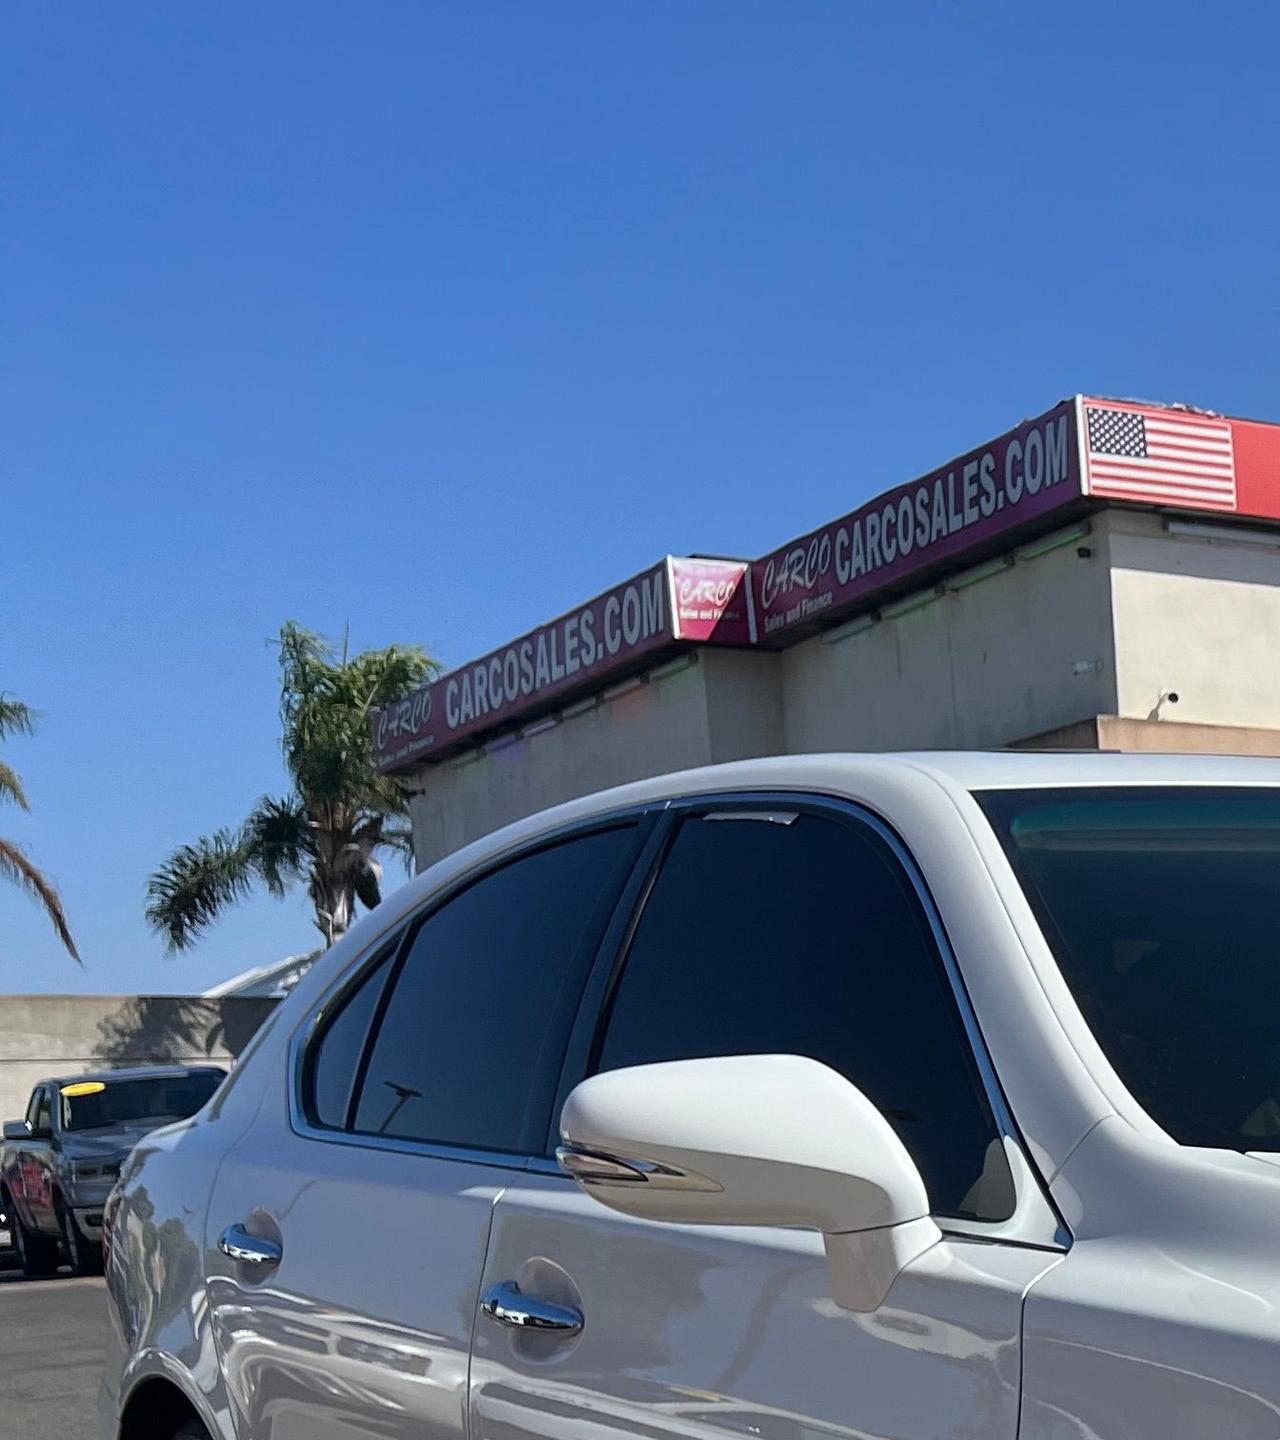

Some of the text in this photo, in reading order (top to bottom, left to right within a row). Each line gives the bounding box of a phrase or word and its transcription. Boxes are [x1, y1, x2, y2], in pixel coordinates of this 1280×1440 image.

[761, 533, 832, 609] CARCO
[833, 413, 1069, 586] CARCOSALES.COM
[444, 570, 664, 731] CARCOSALES.COM
